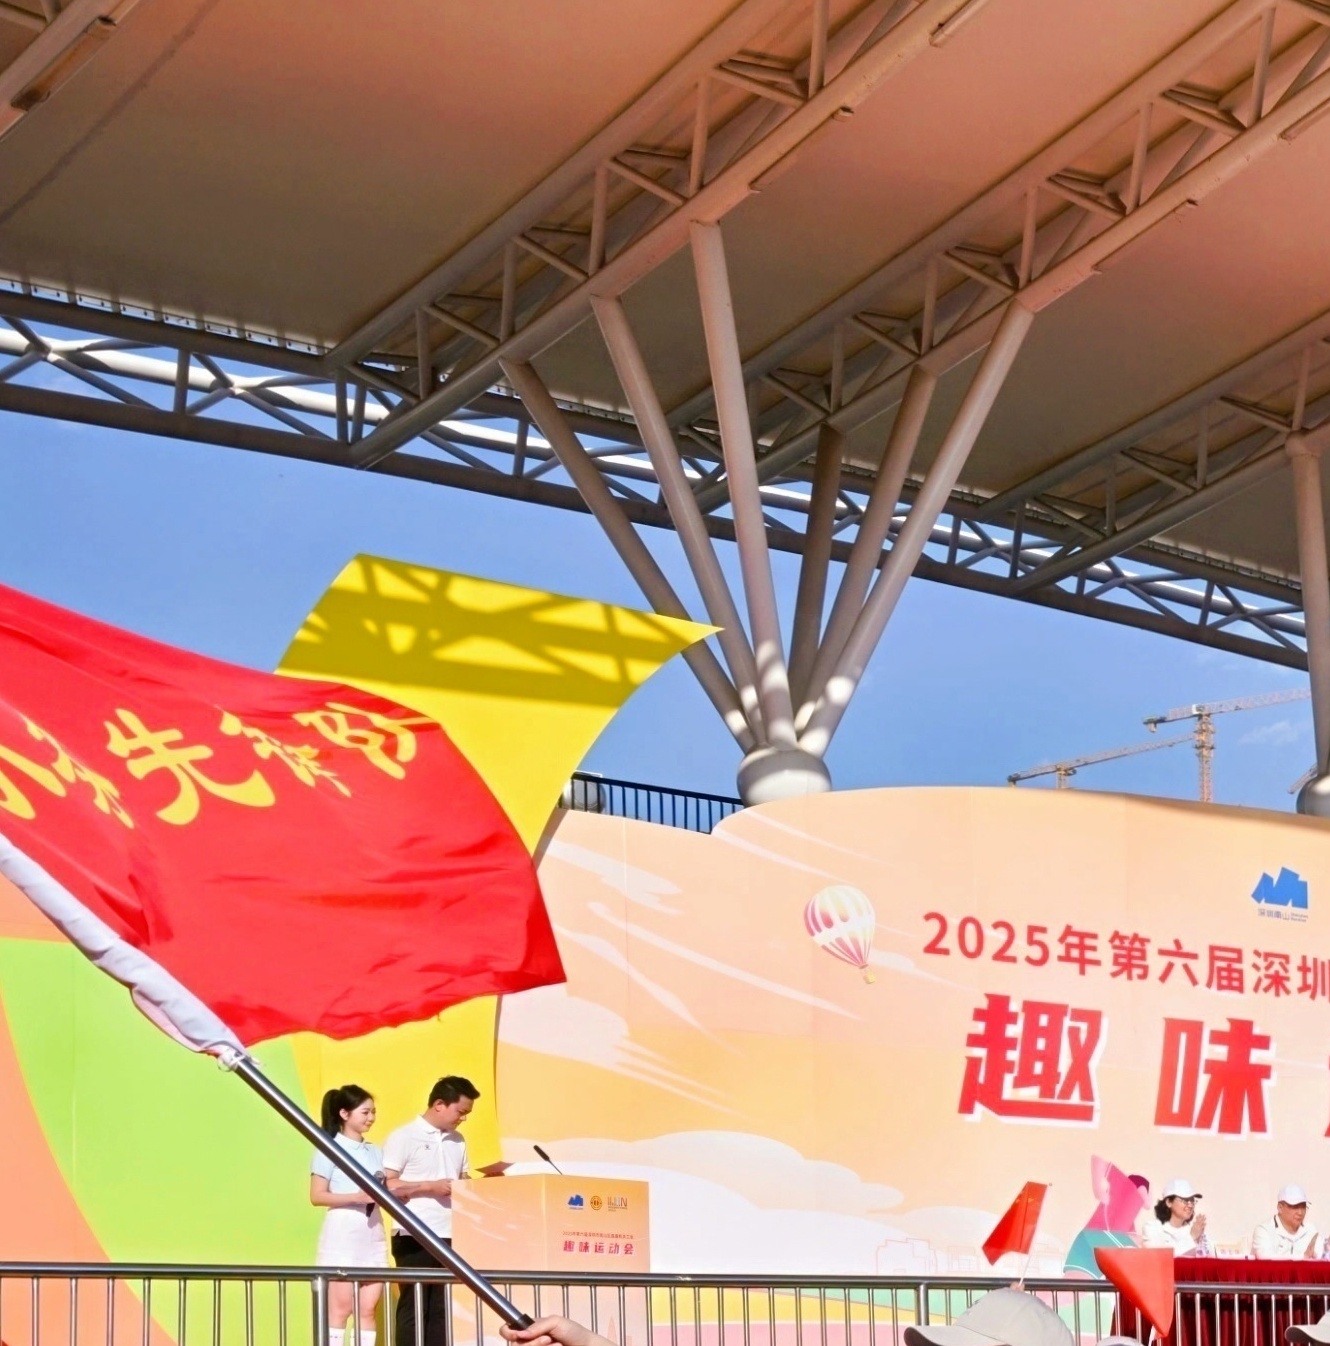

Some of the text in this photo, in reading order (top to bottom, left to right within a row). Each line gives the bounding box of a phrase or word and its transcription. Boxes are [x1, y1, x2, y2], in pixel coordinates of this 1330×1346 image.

[563, 1240, 634, 1255] 趣味运动会
